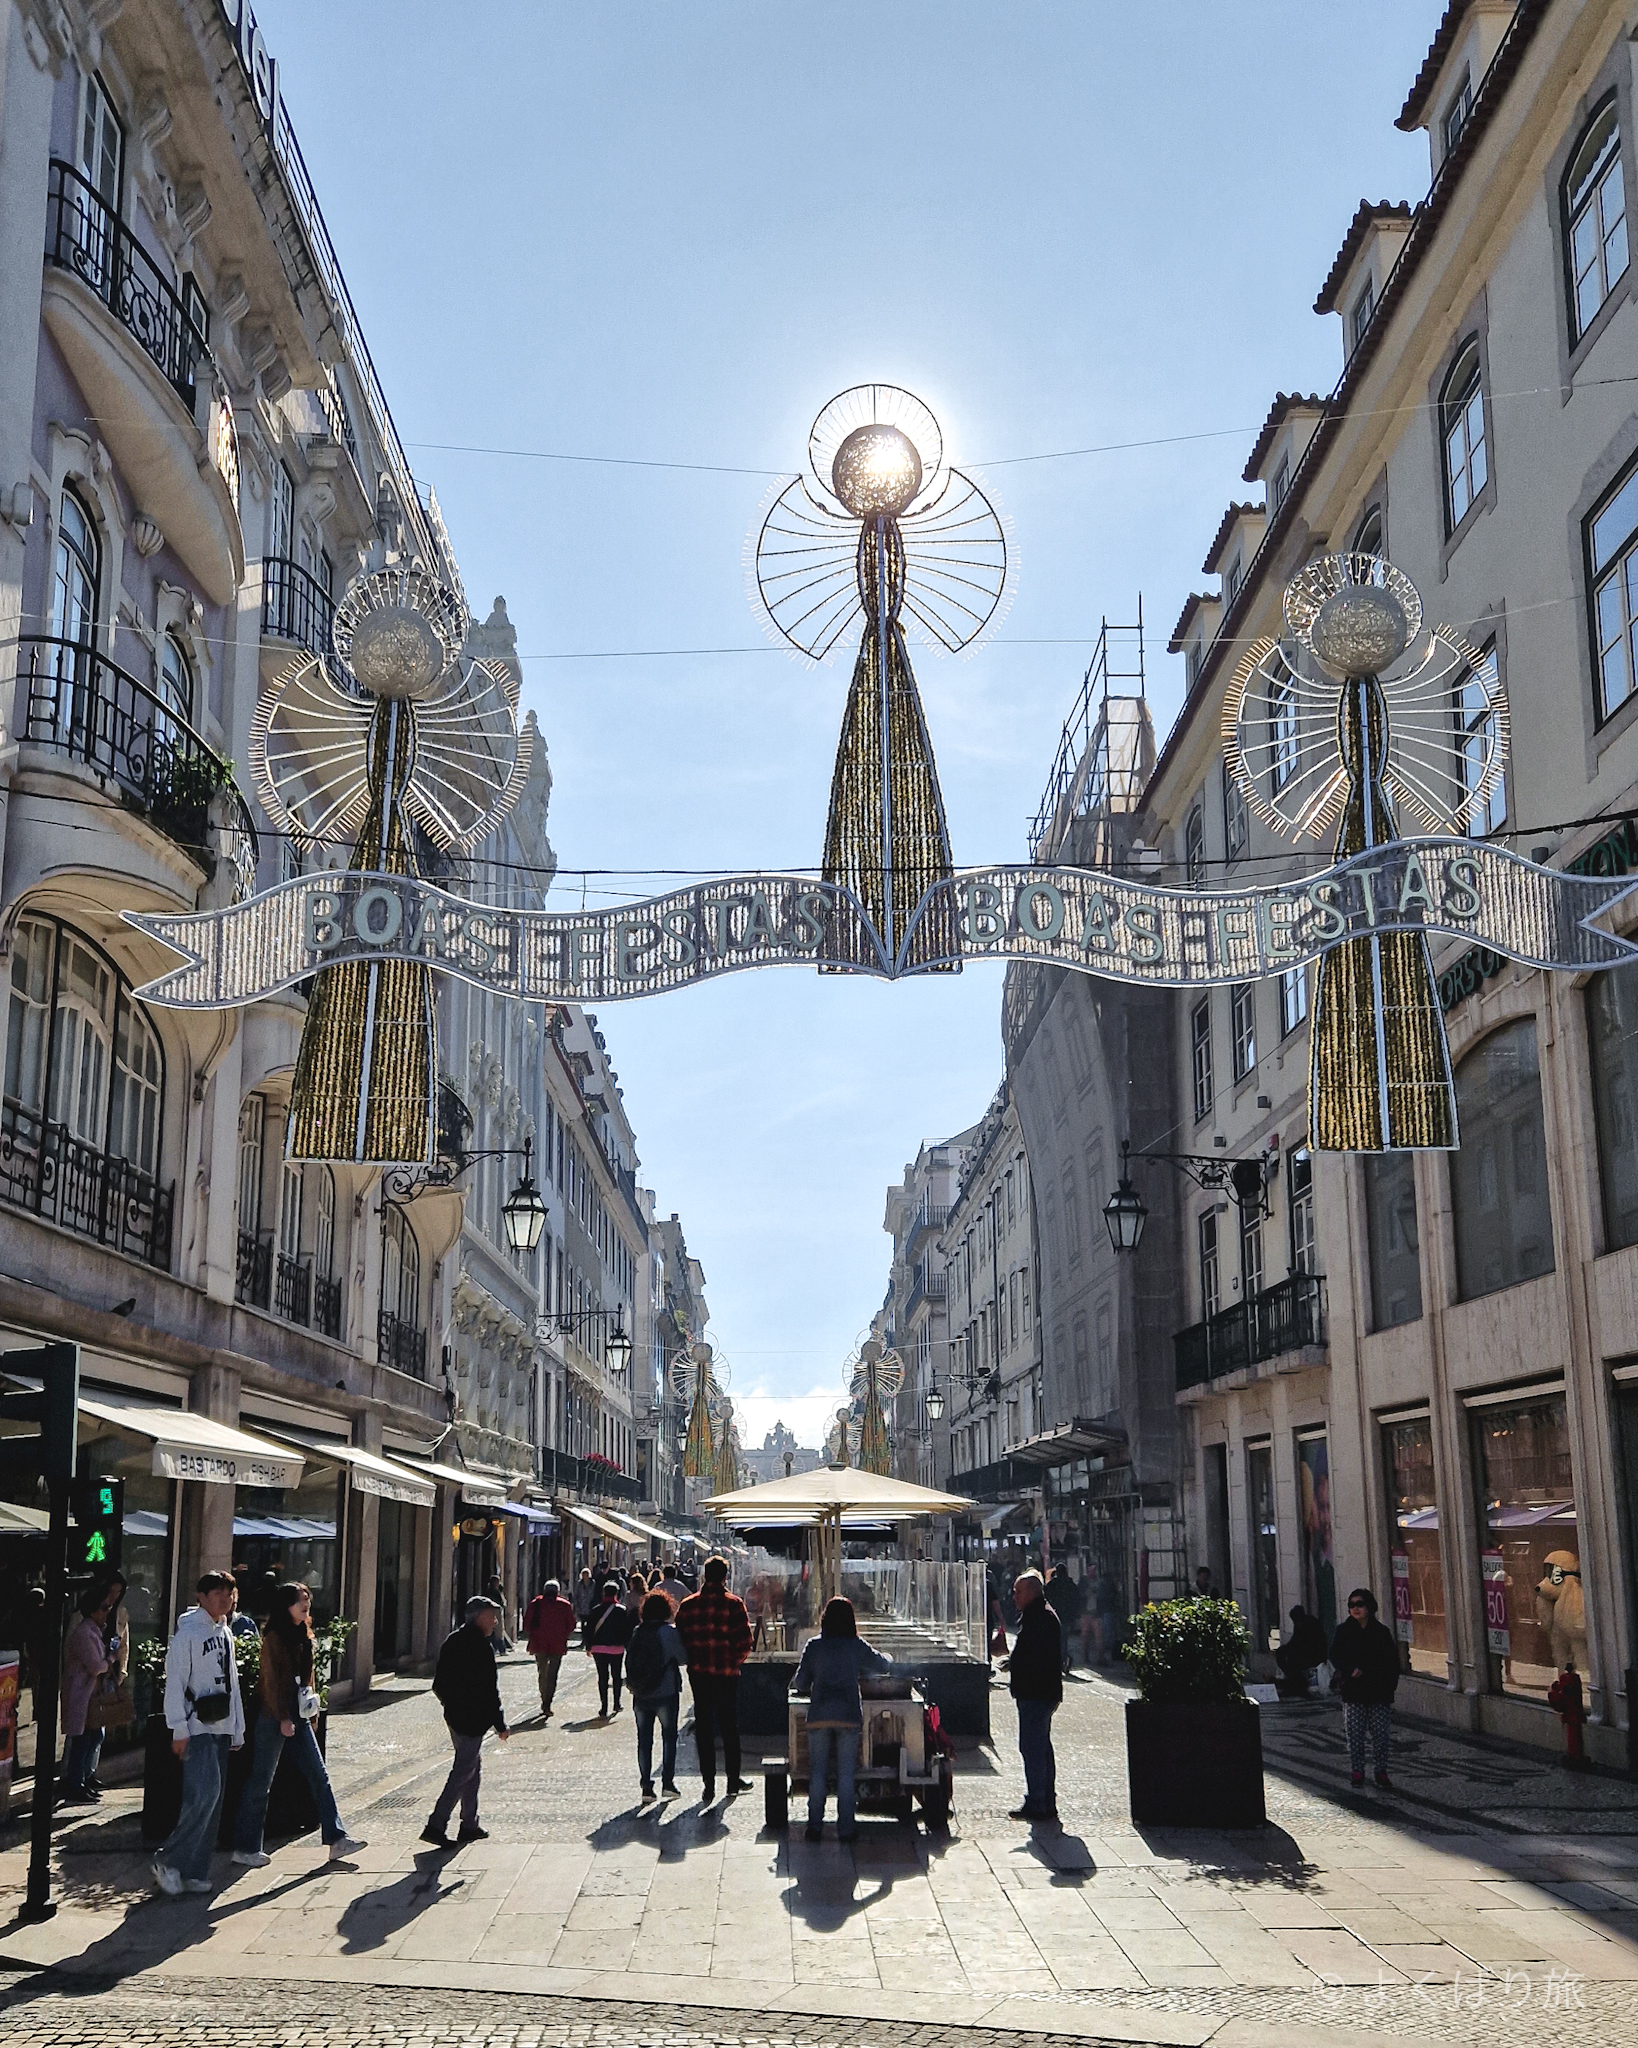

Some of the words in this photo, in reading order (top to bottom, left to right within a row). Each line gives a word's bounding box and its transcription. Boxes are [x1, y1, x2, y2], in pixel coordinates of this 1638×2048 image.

[221, 0, 281, 151] tel
[304, 887, 496, 972] BOAS
[571, 889, 832, 987] FESTAS
[967, 881, 1163, 963] BOAS
[1217, 854, 1483, 968] FESTAS
[180, 1454, 236, 1478] BASTARDO
[1395, 1586, 1410, 1616] 50
[1487, 1591, 1505, 1625] 50
